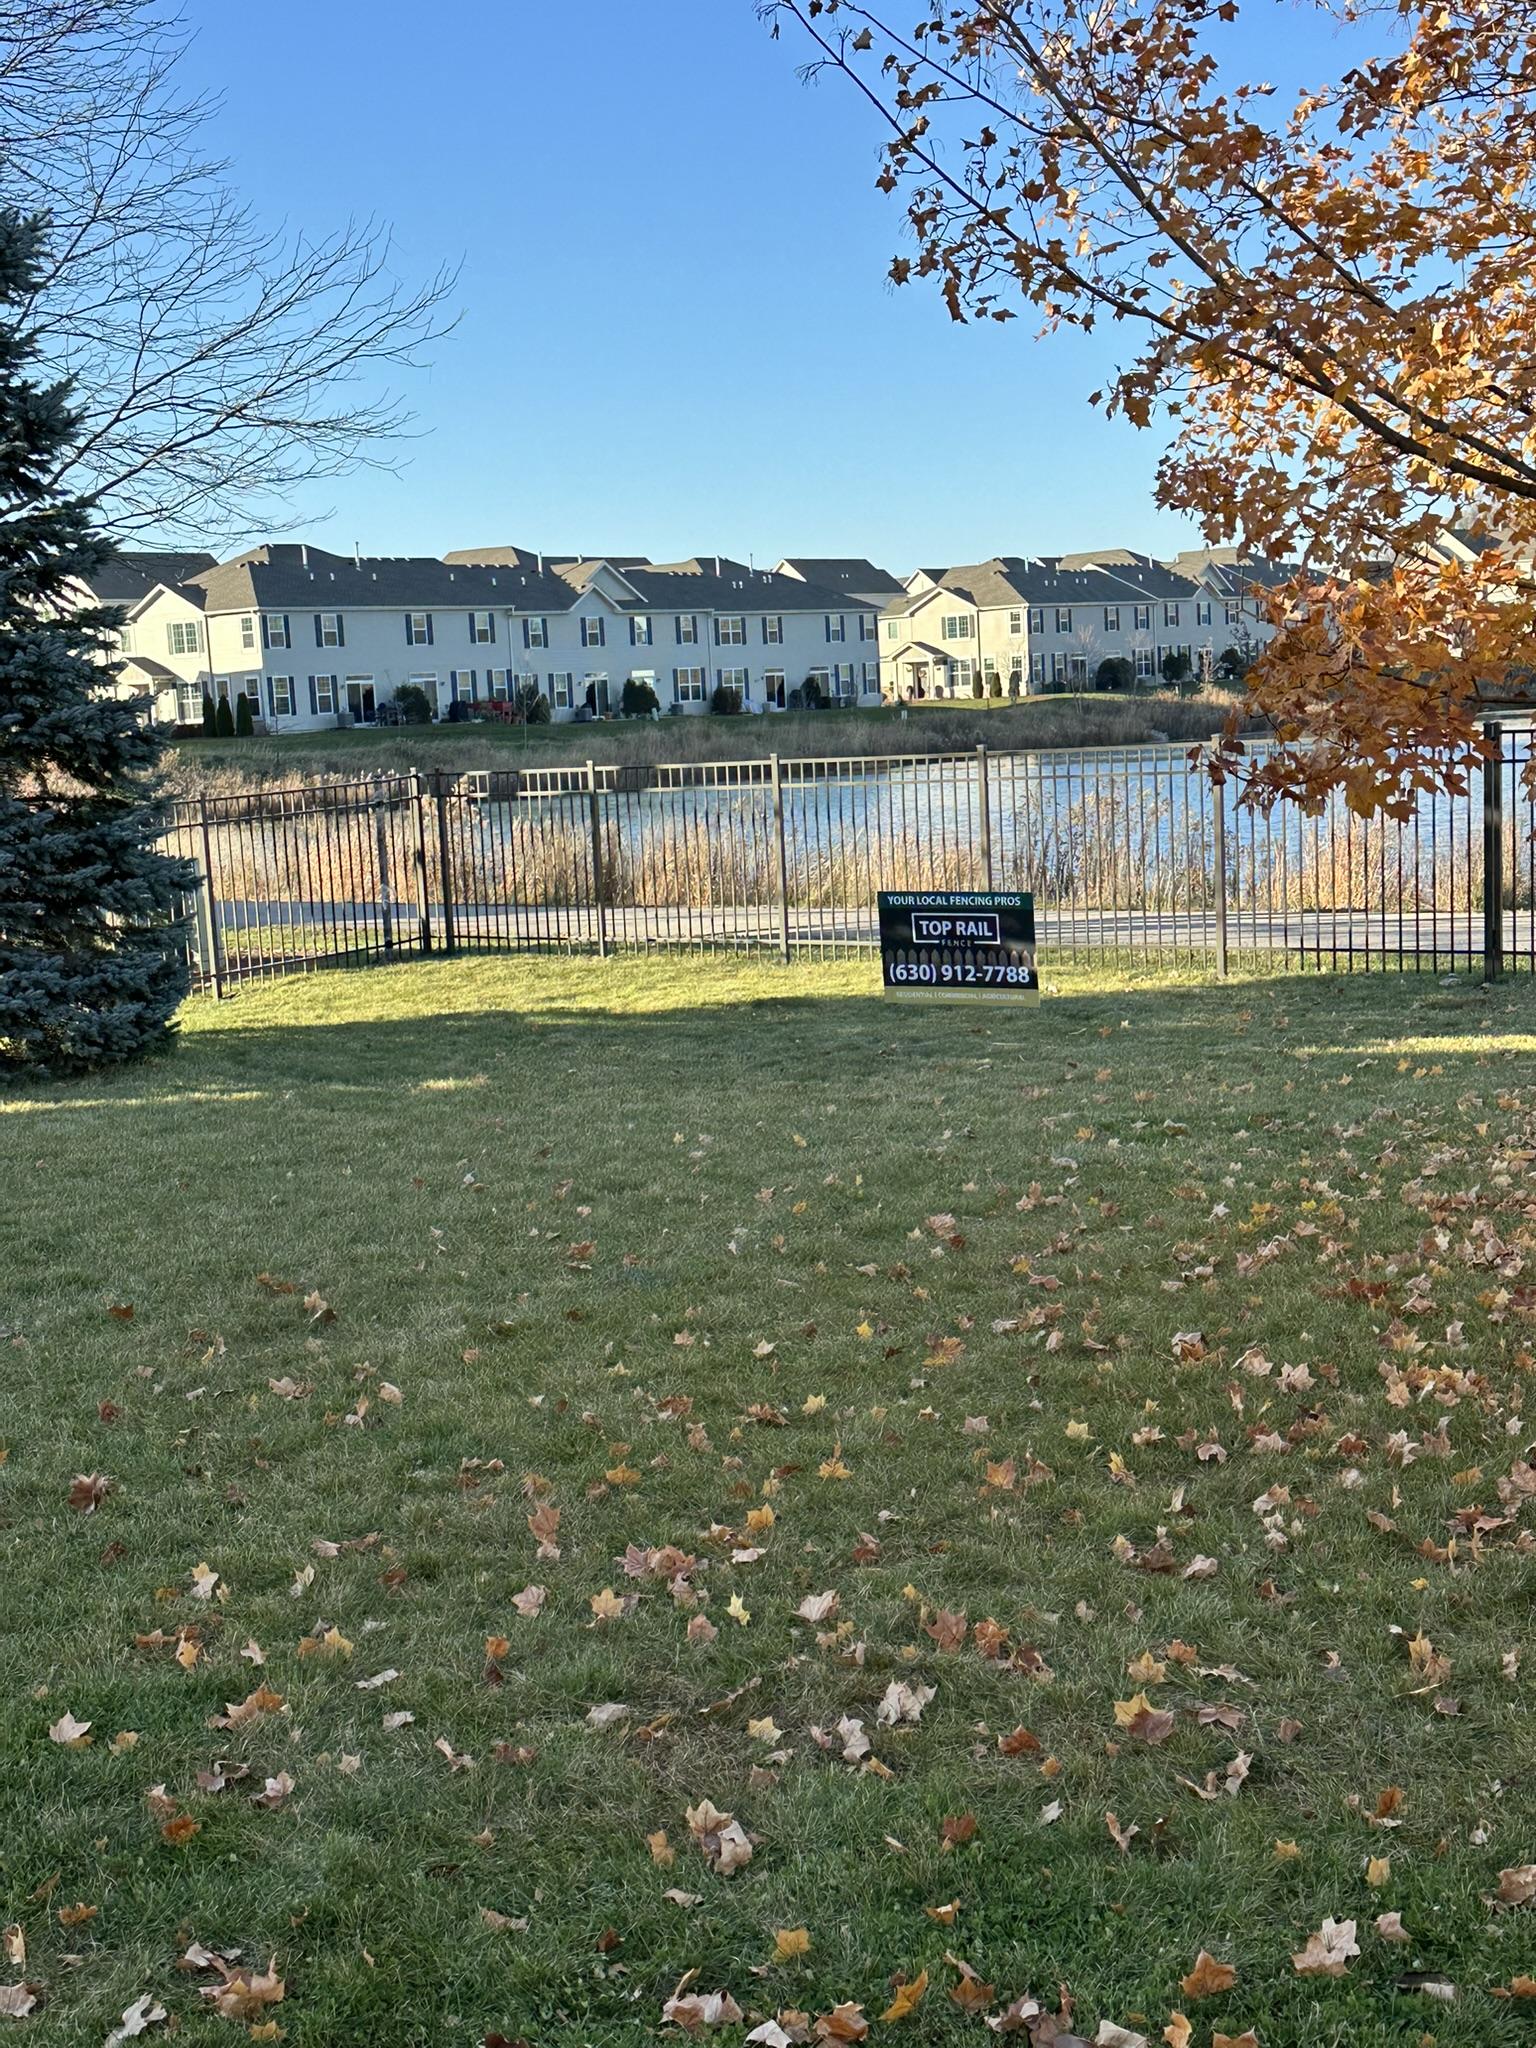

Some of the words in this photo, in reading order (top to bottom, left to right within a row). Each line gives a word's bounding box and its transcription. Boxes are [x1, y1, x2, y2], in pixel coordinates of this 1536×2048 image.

[887, 895, 915, 905] YOUR
[916, 895, 948, 906] LOCAL
[950, 895, 993, 906] FENCING
[994, 896, 1021, 906] PROS
[919, 920, 952, 936] TOP
[956, 921, 993, 936] RAIL
[941, 939, 972, 948] FENCE
[890, 963, 937, 983] (630)
[941, 964, 1030, 983] 912-7788
